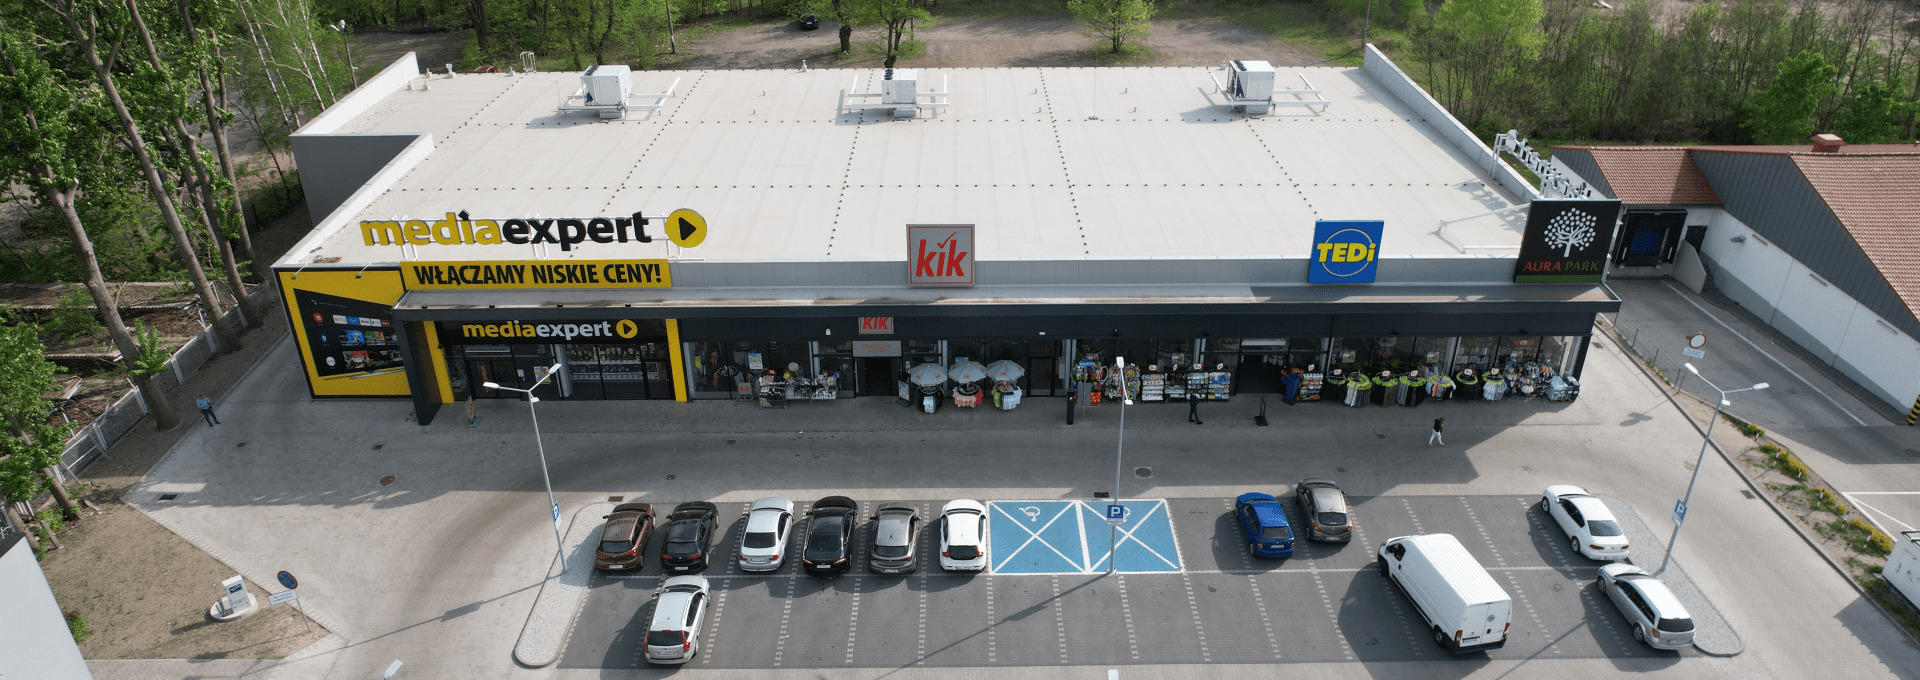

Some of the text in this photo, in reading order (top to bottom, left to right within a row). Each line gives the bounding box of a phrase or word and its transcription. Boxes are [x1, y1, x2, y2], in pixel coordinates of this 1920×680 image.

[359, 209, 652, 251] mediaexpert
[1316, 241, 1377, 264] TEDi
[413, 262, 663, 286] WŁĄCZAMY NISKIE CENY!
[1523, 261, 1601, 272] AURA PARK
[462, 319, 613, 341] mediaexpert
[1111, 507, 1121, 517] P
